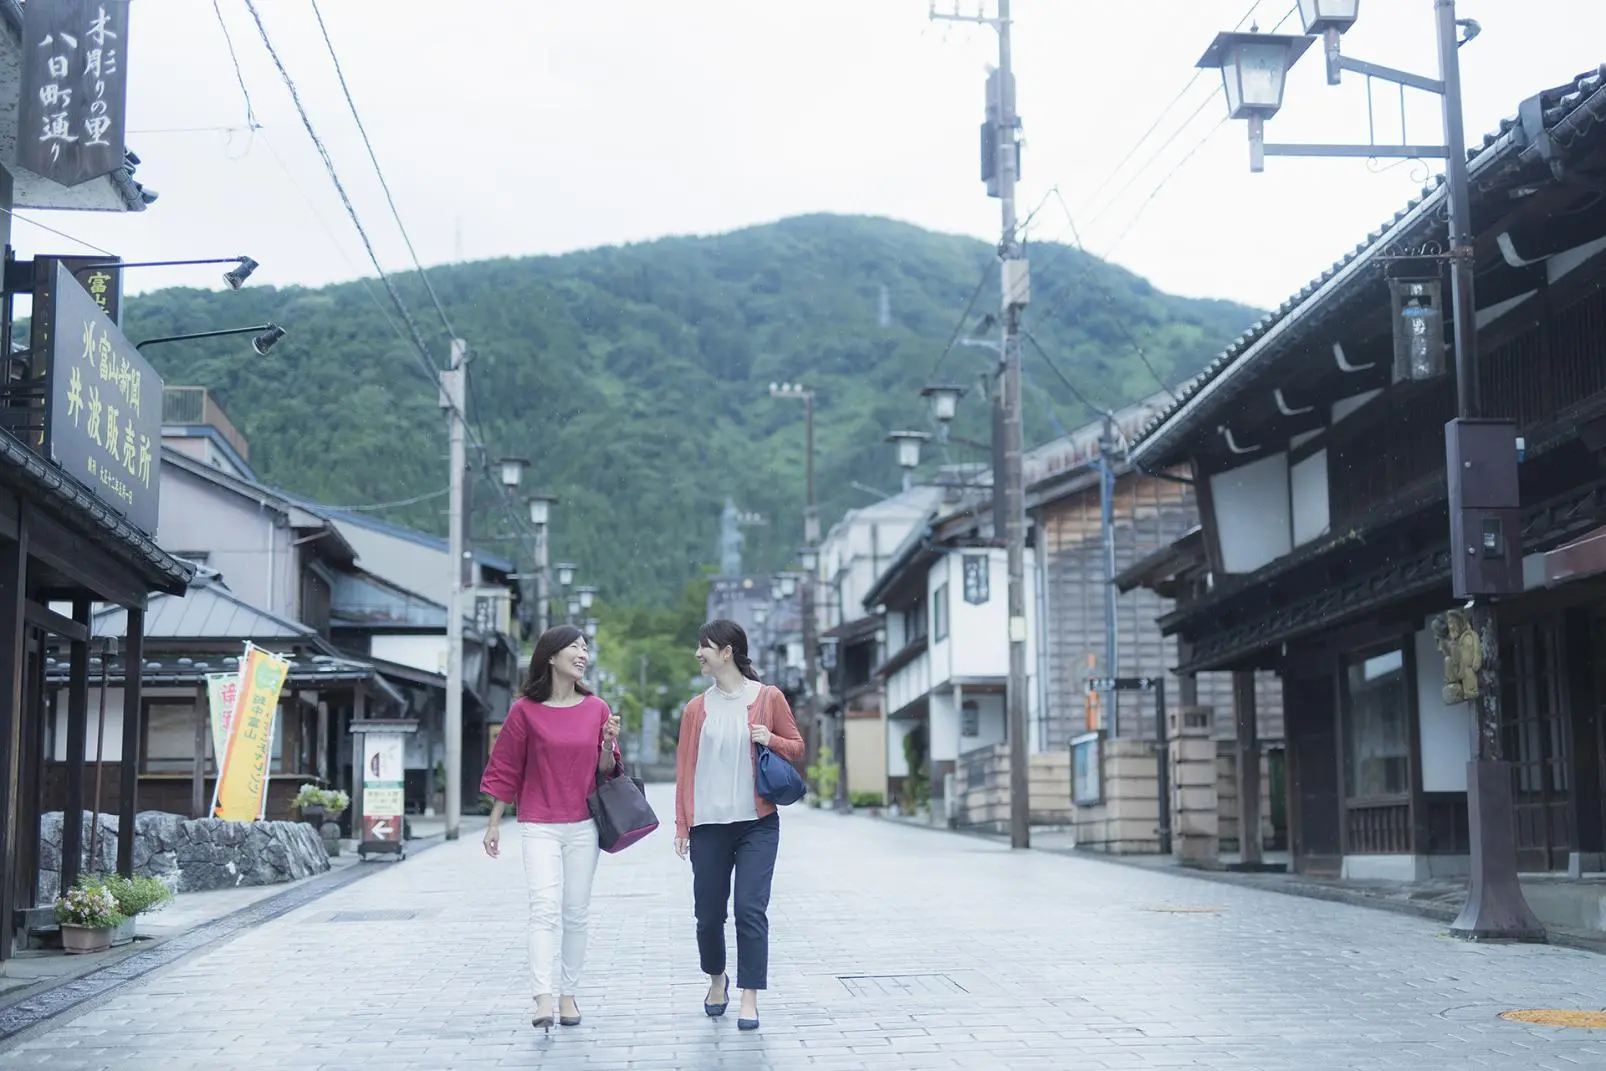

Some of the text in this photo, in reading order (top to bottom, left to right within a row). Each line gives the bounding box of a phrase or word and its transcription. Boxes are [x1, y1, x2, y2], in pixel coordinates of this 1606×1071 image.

[38, 32, 79, 163] 八日町通り
[83, 6, 117, 147] 木彫りの里
[67, 366, 152, 490] 井波販売所
